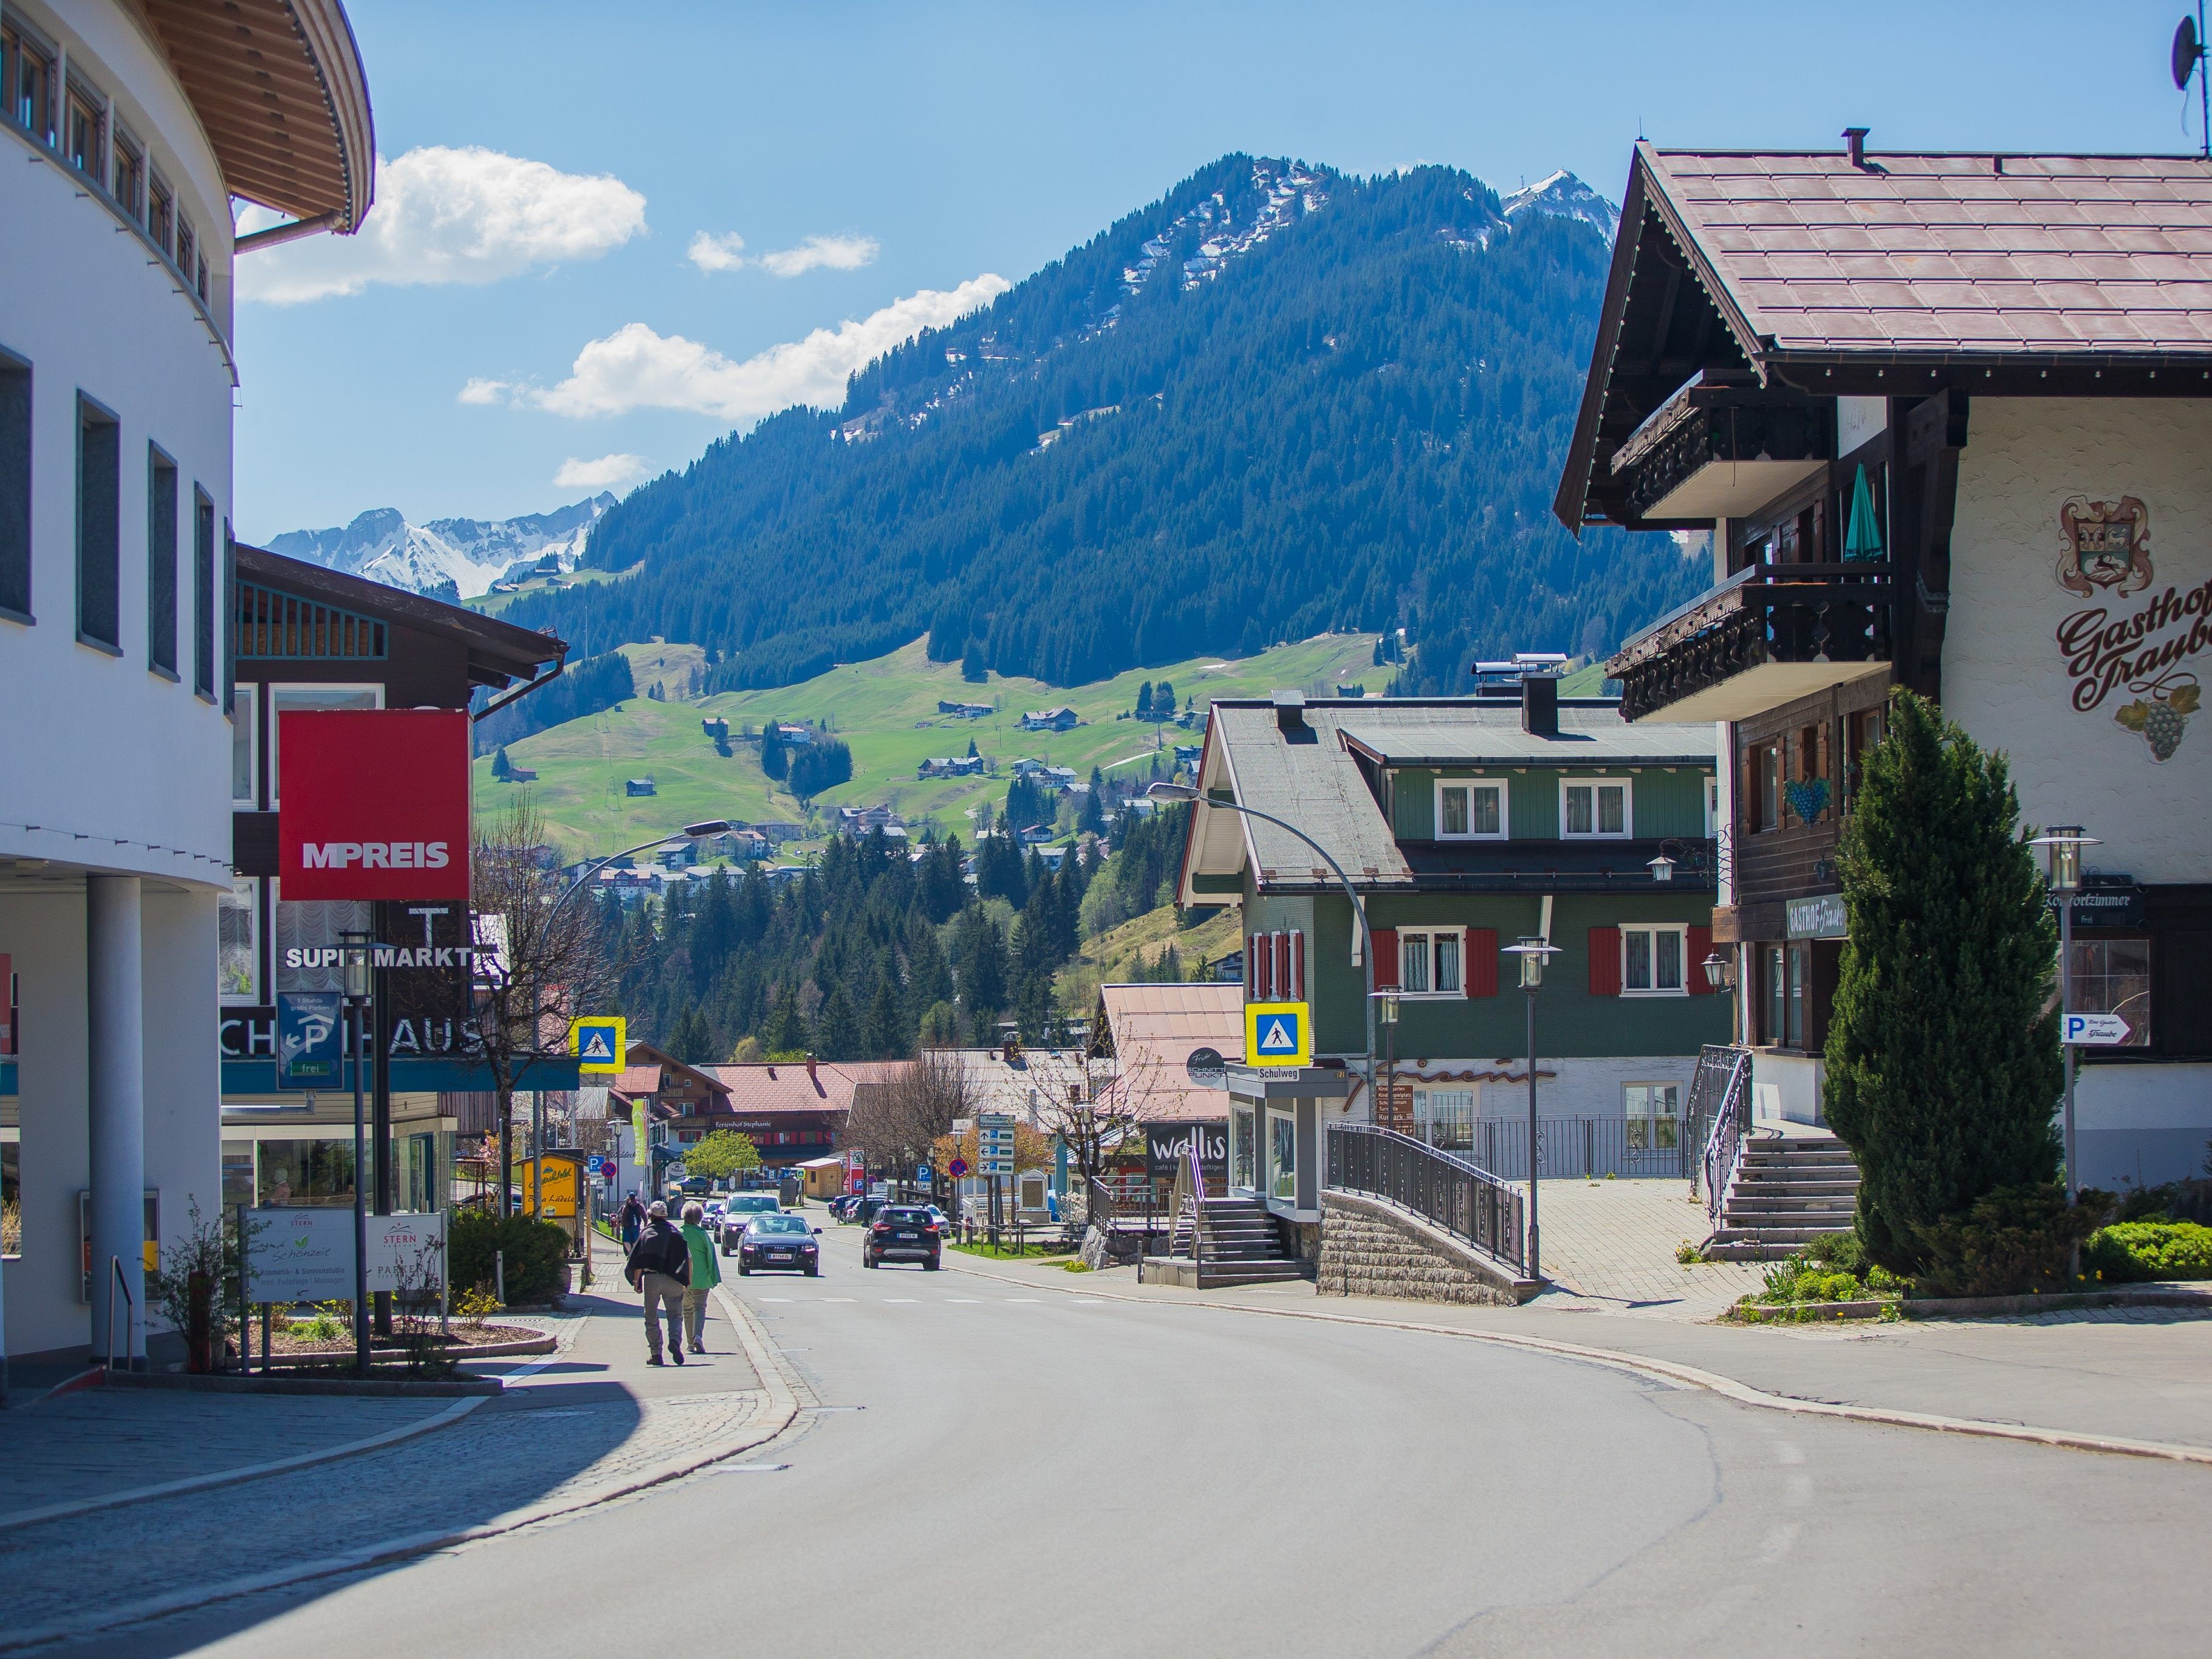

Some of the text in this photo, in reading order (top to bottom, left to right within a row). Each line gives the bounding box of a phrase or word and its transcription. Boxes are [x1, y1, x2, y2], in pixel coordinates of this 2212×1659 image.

[2072, 616, 2212, 712] Traub
[303, 842, 449, 869] MPREIS
[2043, 893, 2131, 907] Kofortzimmer
[1790, 899, 1844, 933] GASTHOF Traube
[286, 948, 471, 968] SUPMARKT
[2069, 1018, 2084, 1039] P
[2087, 1029, 2118, 1038] Traube
[306, 1025, 329, 1053] P
[302, 1064, 320, 1073] frei
[1259, 1068, 1298, 1080] Schulweg
[1152, 1126, 1226, 1160] wallis
[384, 1235, 416, 1243] STERN
[273, 1248, 331, 1262] Schönzeit
[278, 1278, 309, 1287] Fußpflege
[315, 1277, 345, 1285] Massagen
